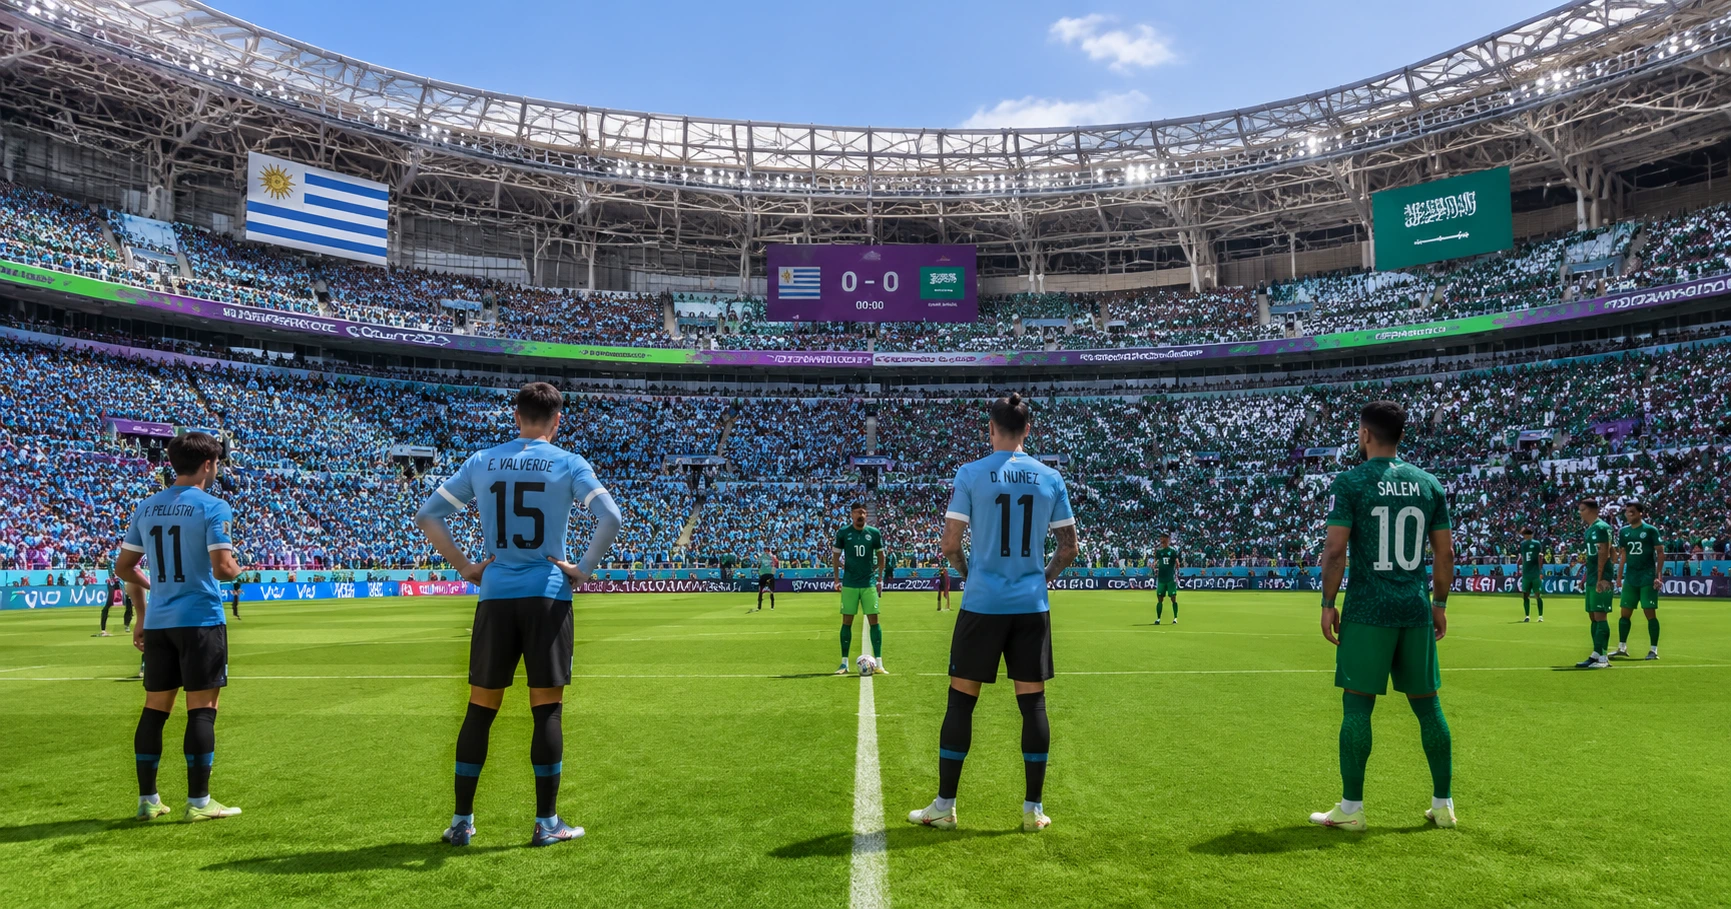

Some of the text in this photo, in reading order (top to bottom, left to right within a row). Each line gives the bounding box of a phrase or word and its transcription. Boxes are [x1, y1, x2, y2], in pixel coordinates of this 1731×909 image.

[841, 271, 857, 292] 0
[883, 271, 899, 292] 0
[855, 300, 884, 310] 00:00
[487, 458, 555, 473] E. VALVERDE
[990, 471, 1001, 483] D.
[1377, 481, 1420, 497] SALEM
[144, 504, 195, 517] F. PELLISTRI
[489, 481, 546, 550] 15
[995, 493, 1034, 558] 11
[1370, 505, 1426, 571] 10
[149, 525, 185, 583] 11
[853, 544, 866, 557] 10
[1627, 541, 1643, 555] 23
